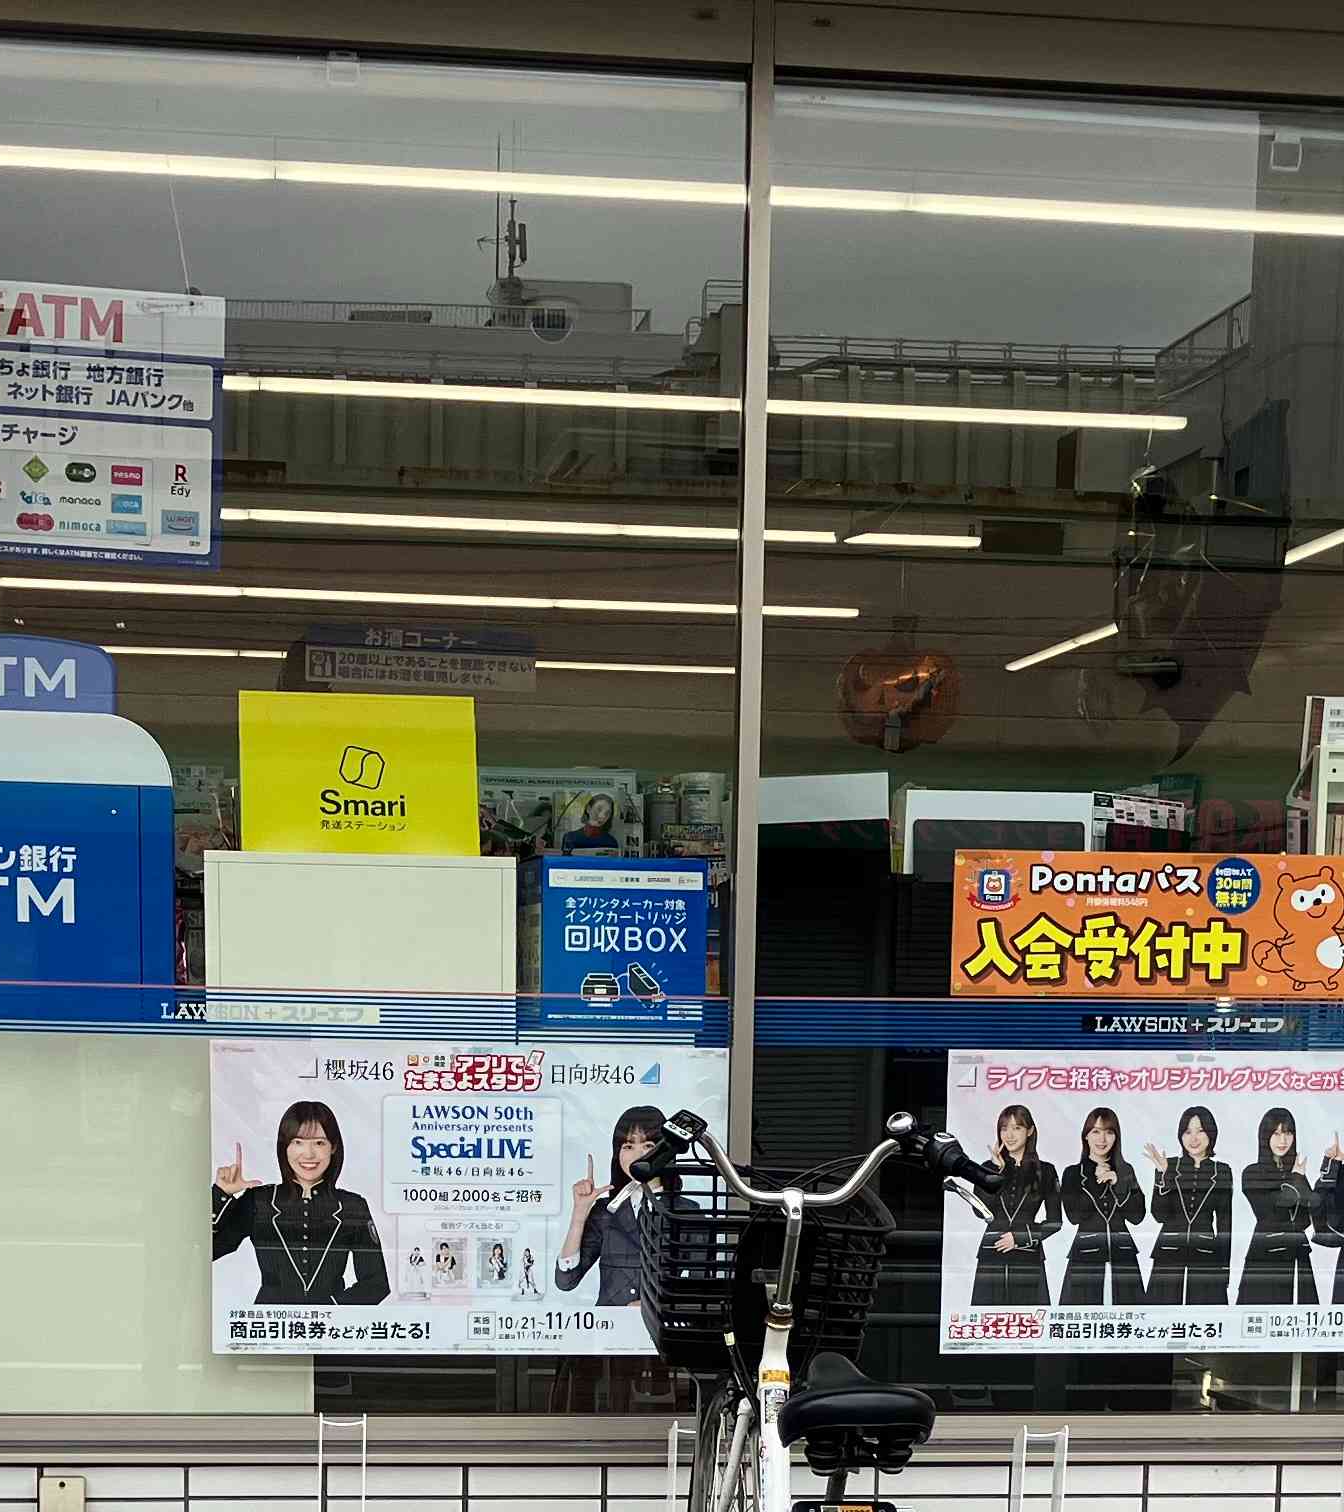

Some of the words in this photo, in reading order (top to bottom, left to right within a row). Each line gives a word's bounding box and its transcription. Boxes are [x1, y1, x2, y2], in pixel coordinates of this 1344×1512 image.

[86, 362, 165, 388] 地方銀行
[6, 381, 94, 407] ネット銀行
[105, 387, 195, 412] JAバンク他
[170, 485, 192, 498] Edy
[59, 520, 102, 532] nimoca
[364, 627, 478, 649] お酒コーナー
[319, 788, 407, 818] Smari
[319, 819, 408, 833] 発送ステーション
[1029, 863, 1202, 895] Pontaパス
[1215, 877, 1253, 891] 30日間
[564, 896, 687, 912] 全プリンタメーカー対象
[1215, 890, 1249, 908] 無料
[564, 911, 688, 926] インクカートリッジ
[564, 924, 688, 954] 回収BOX
[962, 913, 1245, 982] 入会受付中
[1094, 1016, 1189, 1033] LAWSON
[1207, 1017, 1285, 1033] スリーエフ
[324, 1057, 395, 1081] 櫻坂46
[455, 1055, 525, 1074] アプリで
[551, 1063, 636, 1085] 日向坂46
[404, 1071, 542, 1092] たまるよスタンプ
[412, 1105, 489, 1119] LAWSON
[494, 1105, 534, 1120] 50th
[412, 1120, 481, 1134] Anniversary
[483, 1121, 534, 1134] presents
[411, 1136, 482, 1164] Special
[487, 1138, 534, 1159] LIVE
[503, 1190, 543, 1203] ご招待
[229, 1320, 431, 1341] 商品引換券などが当たる!
[1049, 1322, 1223, 1340] 商品引換券などが当たる!
